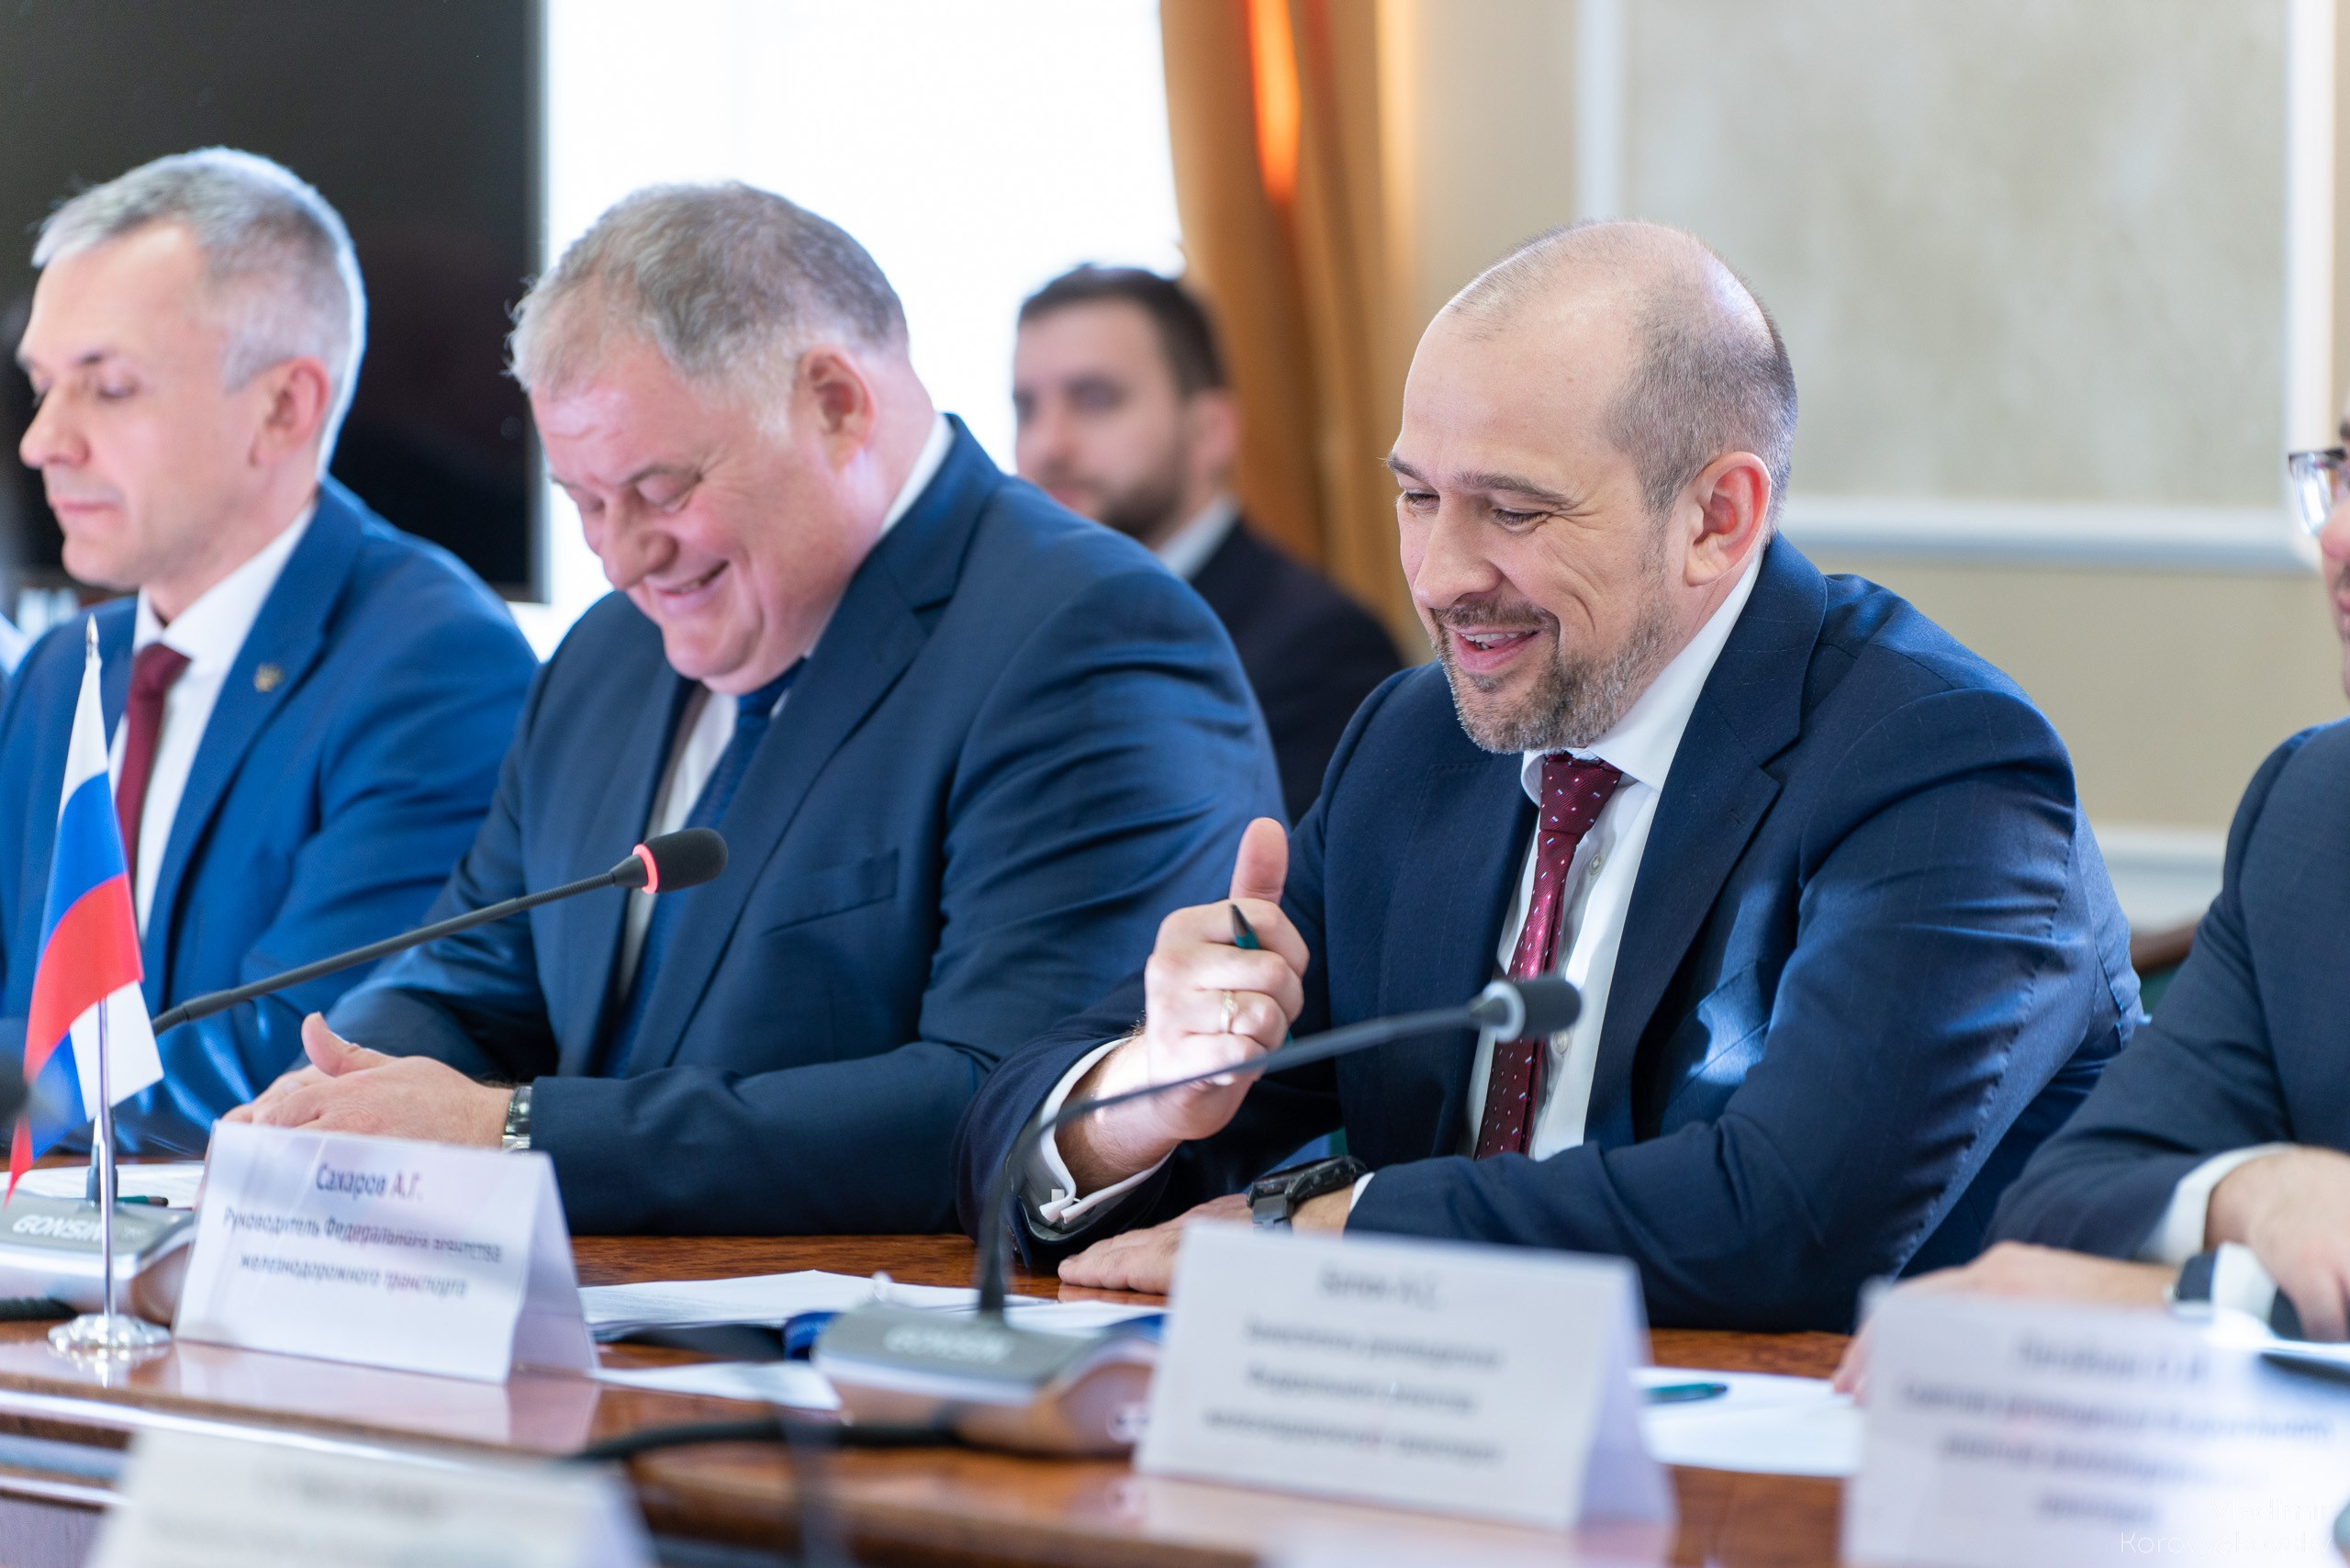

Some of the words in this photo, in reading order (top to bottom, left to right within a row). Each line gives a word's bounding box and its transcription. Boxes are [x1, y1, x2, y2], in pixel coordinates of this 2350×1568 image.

[315, 1162, 387, 1201] Сахаров
[223, 1204, 320, 1237] Руководитель
[324, 1215, 429, 1249] Федерального
[240, 1254, 380, 1287] железнодорожного
[384, 1269, 469, 1298] транспорта
